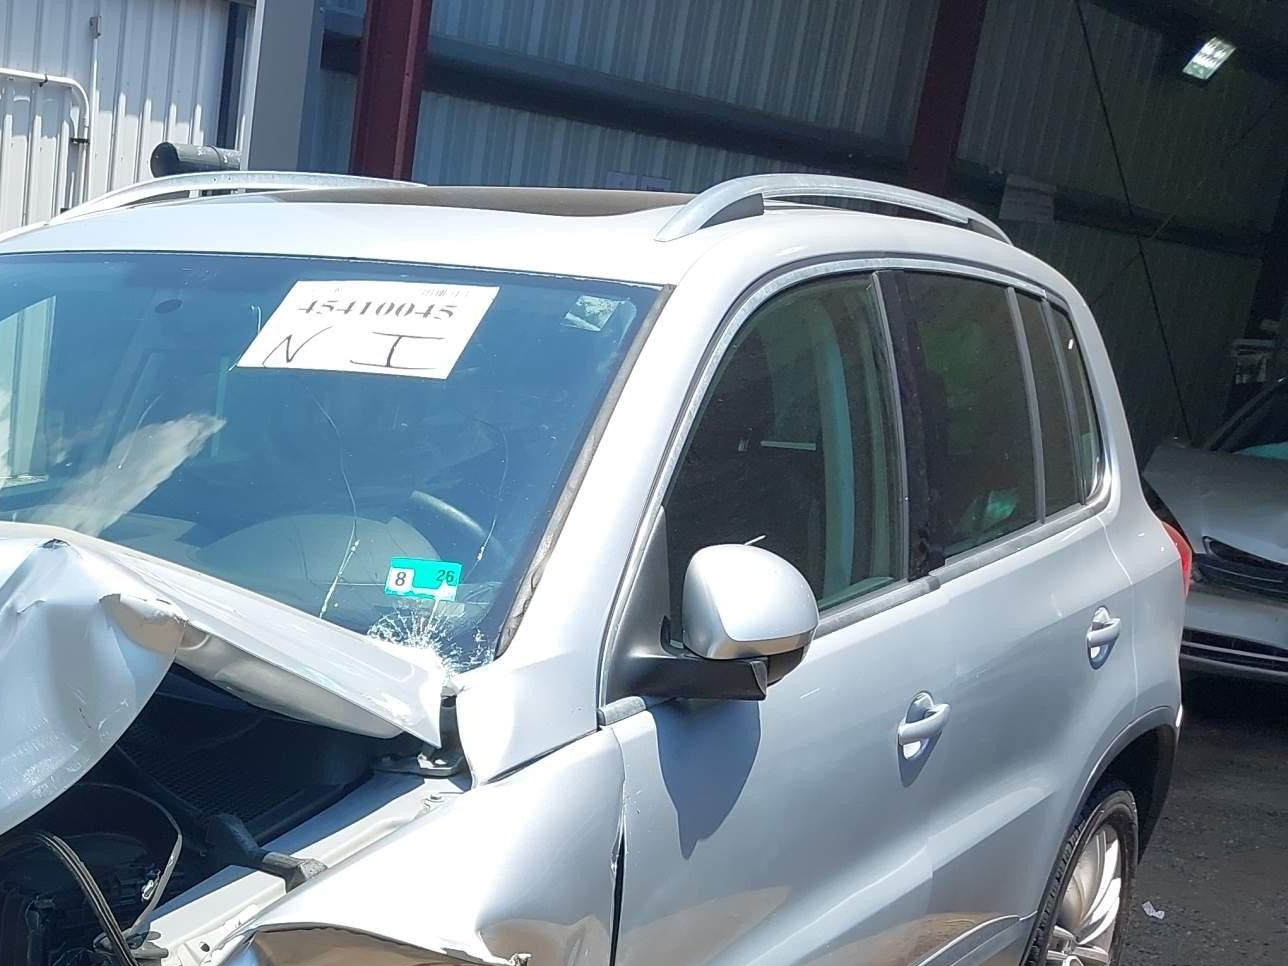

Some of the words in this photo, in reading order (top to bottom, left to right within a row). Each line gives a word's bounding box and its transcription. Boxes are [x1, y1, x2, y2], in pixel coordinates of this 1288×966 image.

[298, 300, 458, 320] 45410045
[395, 571, 407, 587] 8
[436, 569, 455, 583] 26
